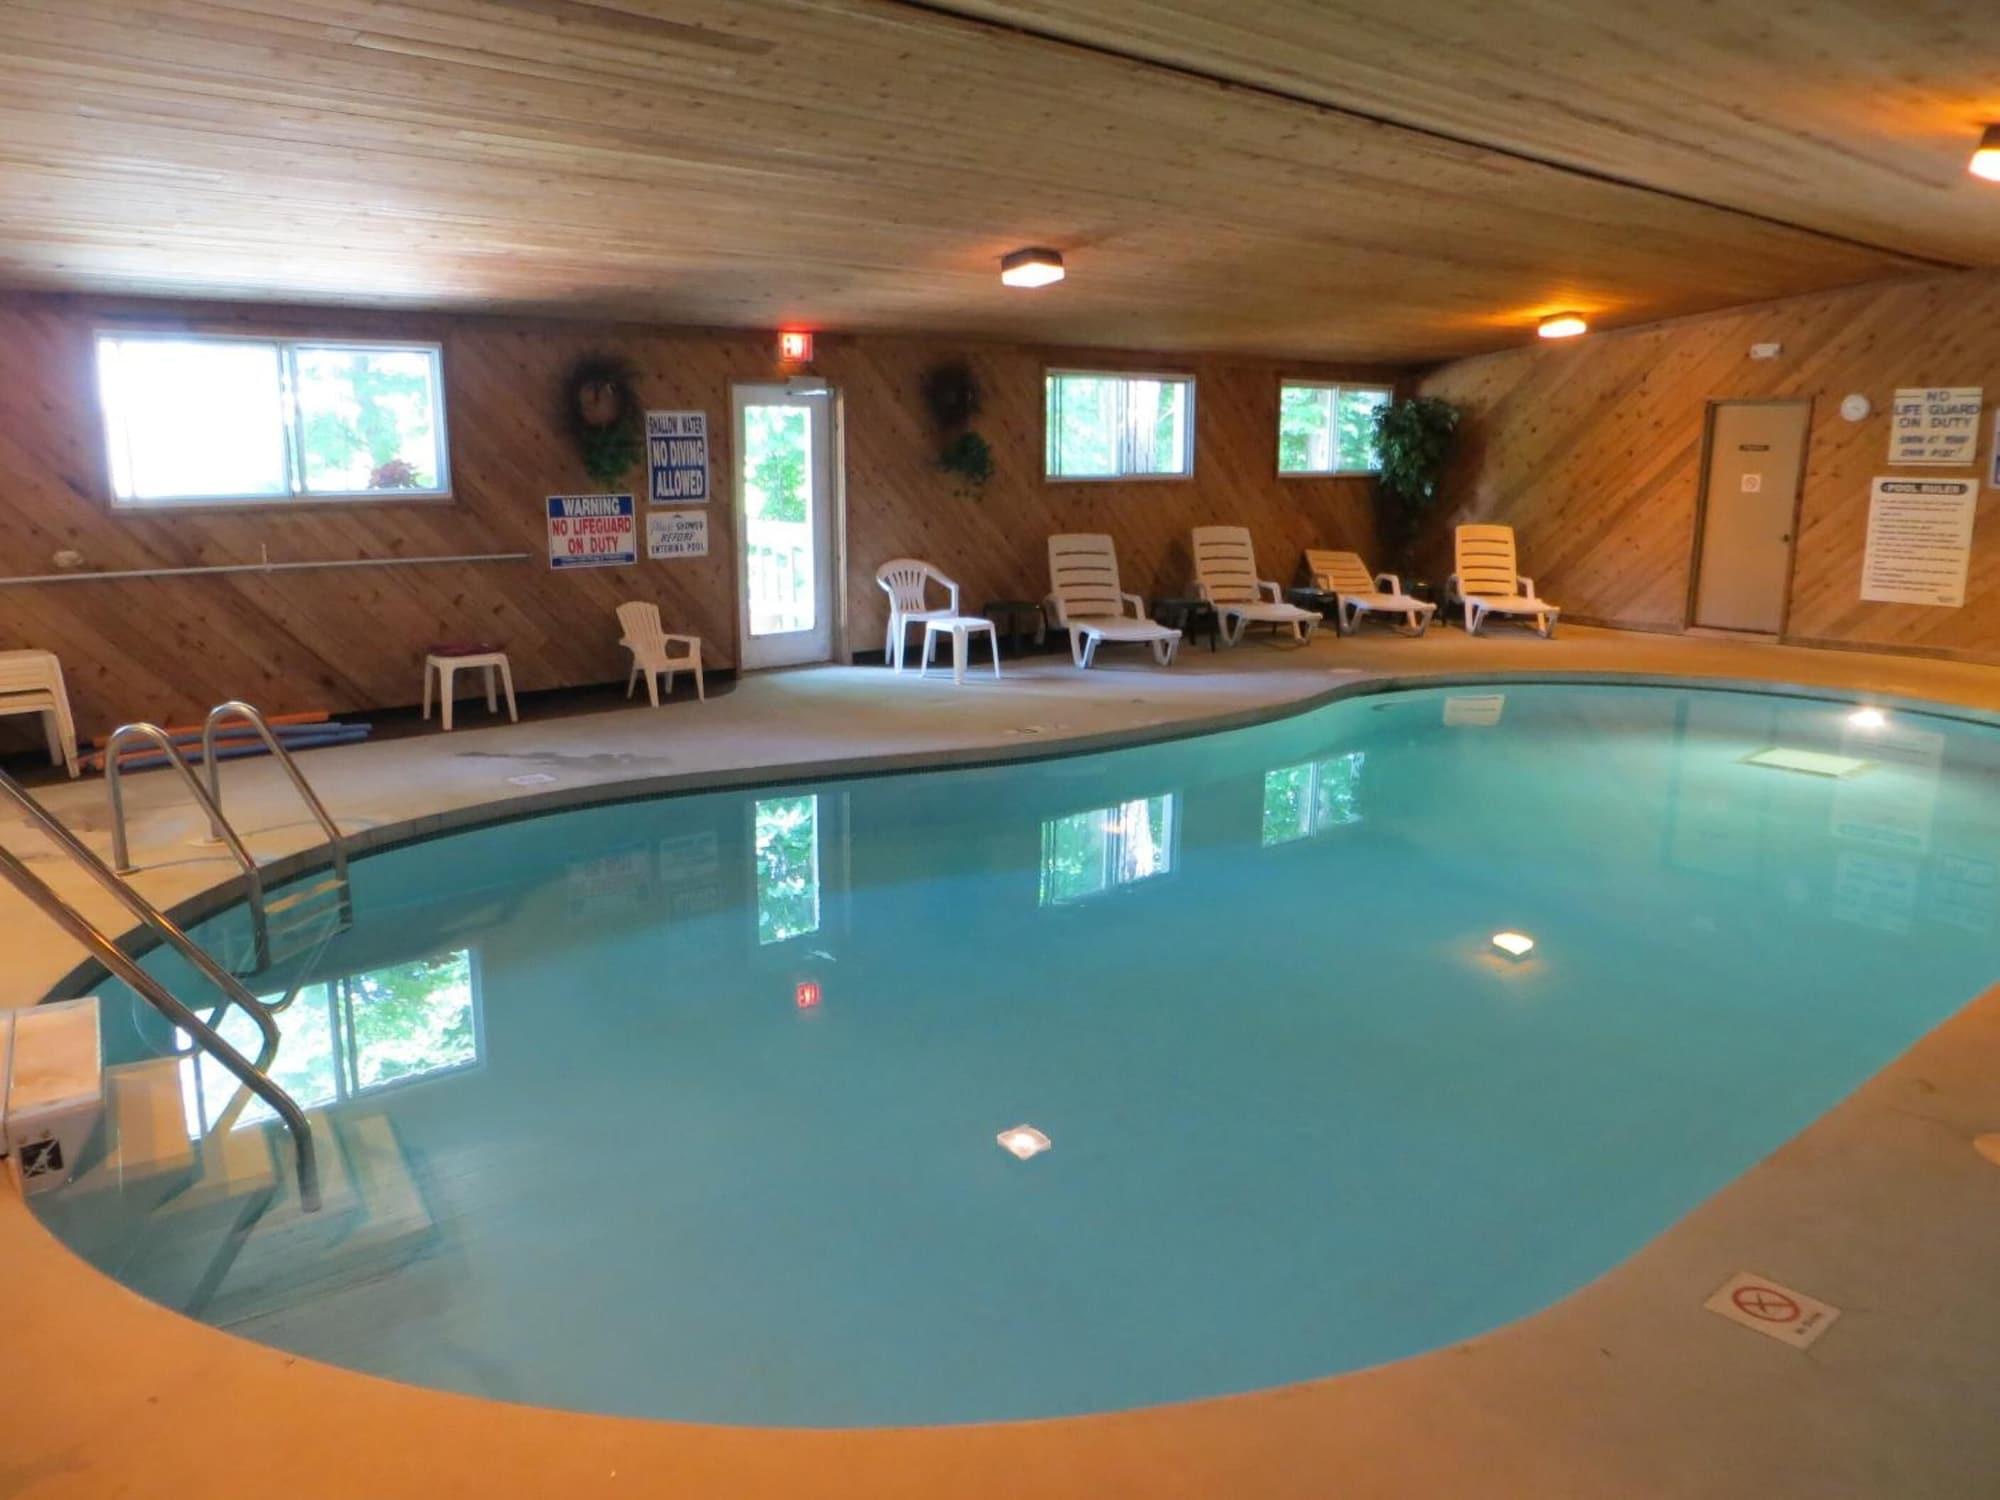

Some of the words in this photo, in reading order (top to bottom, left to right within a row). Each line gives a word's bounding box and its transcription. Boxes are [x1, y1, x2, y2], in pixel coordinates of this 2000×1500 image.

[1927, 391, 1951, 402] NO
[1895, 404, 1921, 415] LIFE
[1928, 404, 1980, 415] GUARD
[649, 416, 677, 433] SHALLOW
[681, 416, 703, 433] WATER
[1899, 417, 1921, 428] ON
[1931, 417, 1972, 428] DUTY
[652, 440, 667, 467] NO
[670, 440, 704, 467] DIVING
[657, 469, 703, 496] ALLOWED
[562, 497, 620, 516] WARNING
[552, 519, 568, 536] NO
[574, 517, 631, 535] LIFEGUARD
[568, 538, 584, 554] ON
[591, 536, 618, 553] DUTY
